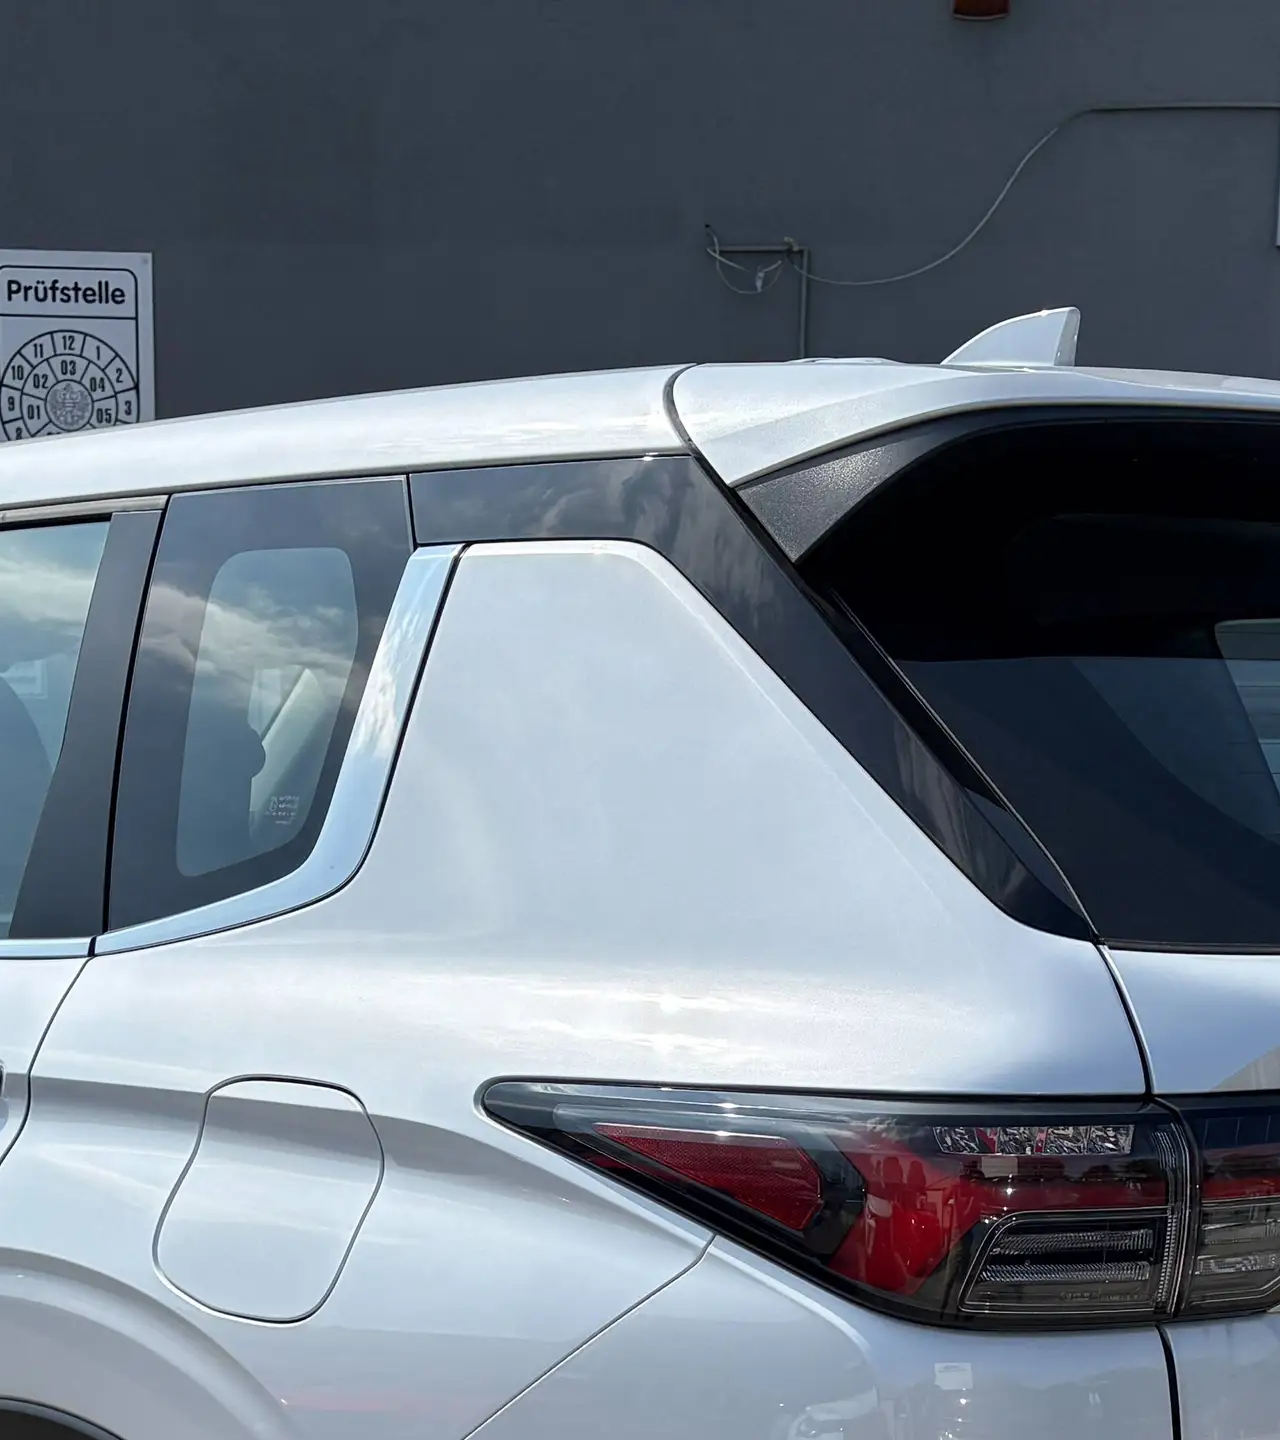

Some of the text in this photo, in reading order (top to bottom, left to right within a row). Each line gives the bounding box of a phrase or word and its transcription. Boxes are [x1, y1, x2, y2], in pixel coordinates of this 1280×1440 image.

[6, 279, 126, 305] Prüfstelle
[33, 343, 44, 358] 11
[61, 335, 76, 351] 12
[95, 345, 101, 361] 1
[11, 364, 24, 381] 10
[60, 360, 76, 376] 03
[115, 368, 123, 383] 2
[33, 373, 49, 389] 02
[89, 377, 105, 392] 04
[7, 396, 15, 412] 9
[27, 404, 41, 420] 01
[124, 400, 132, 416] 3
[96, 408, 112, 424] 05
